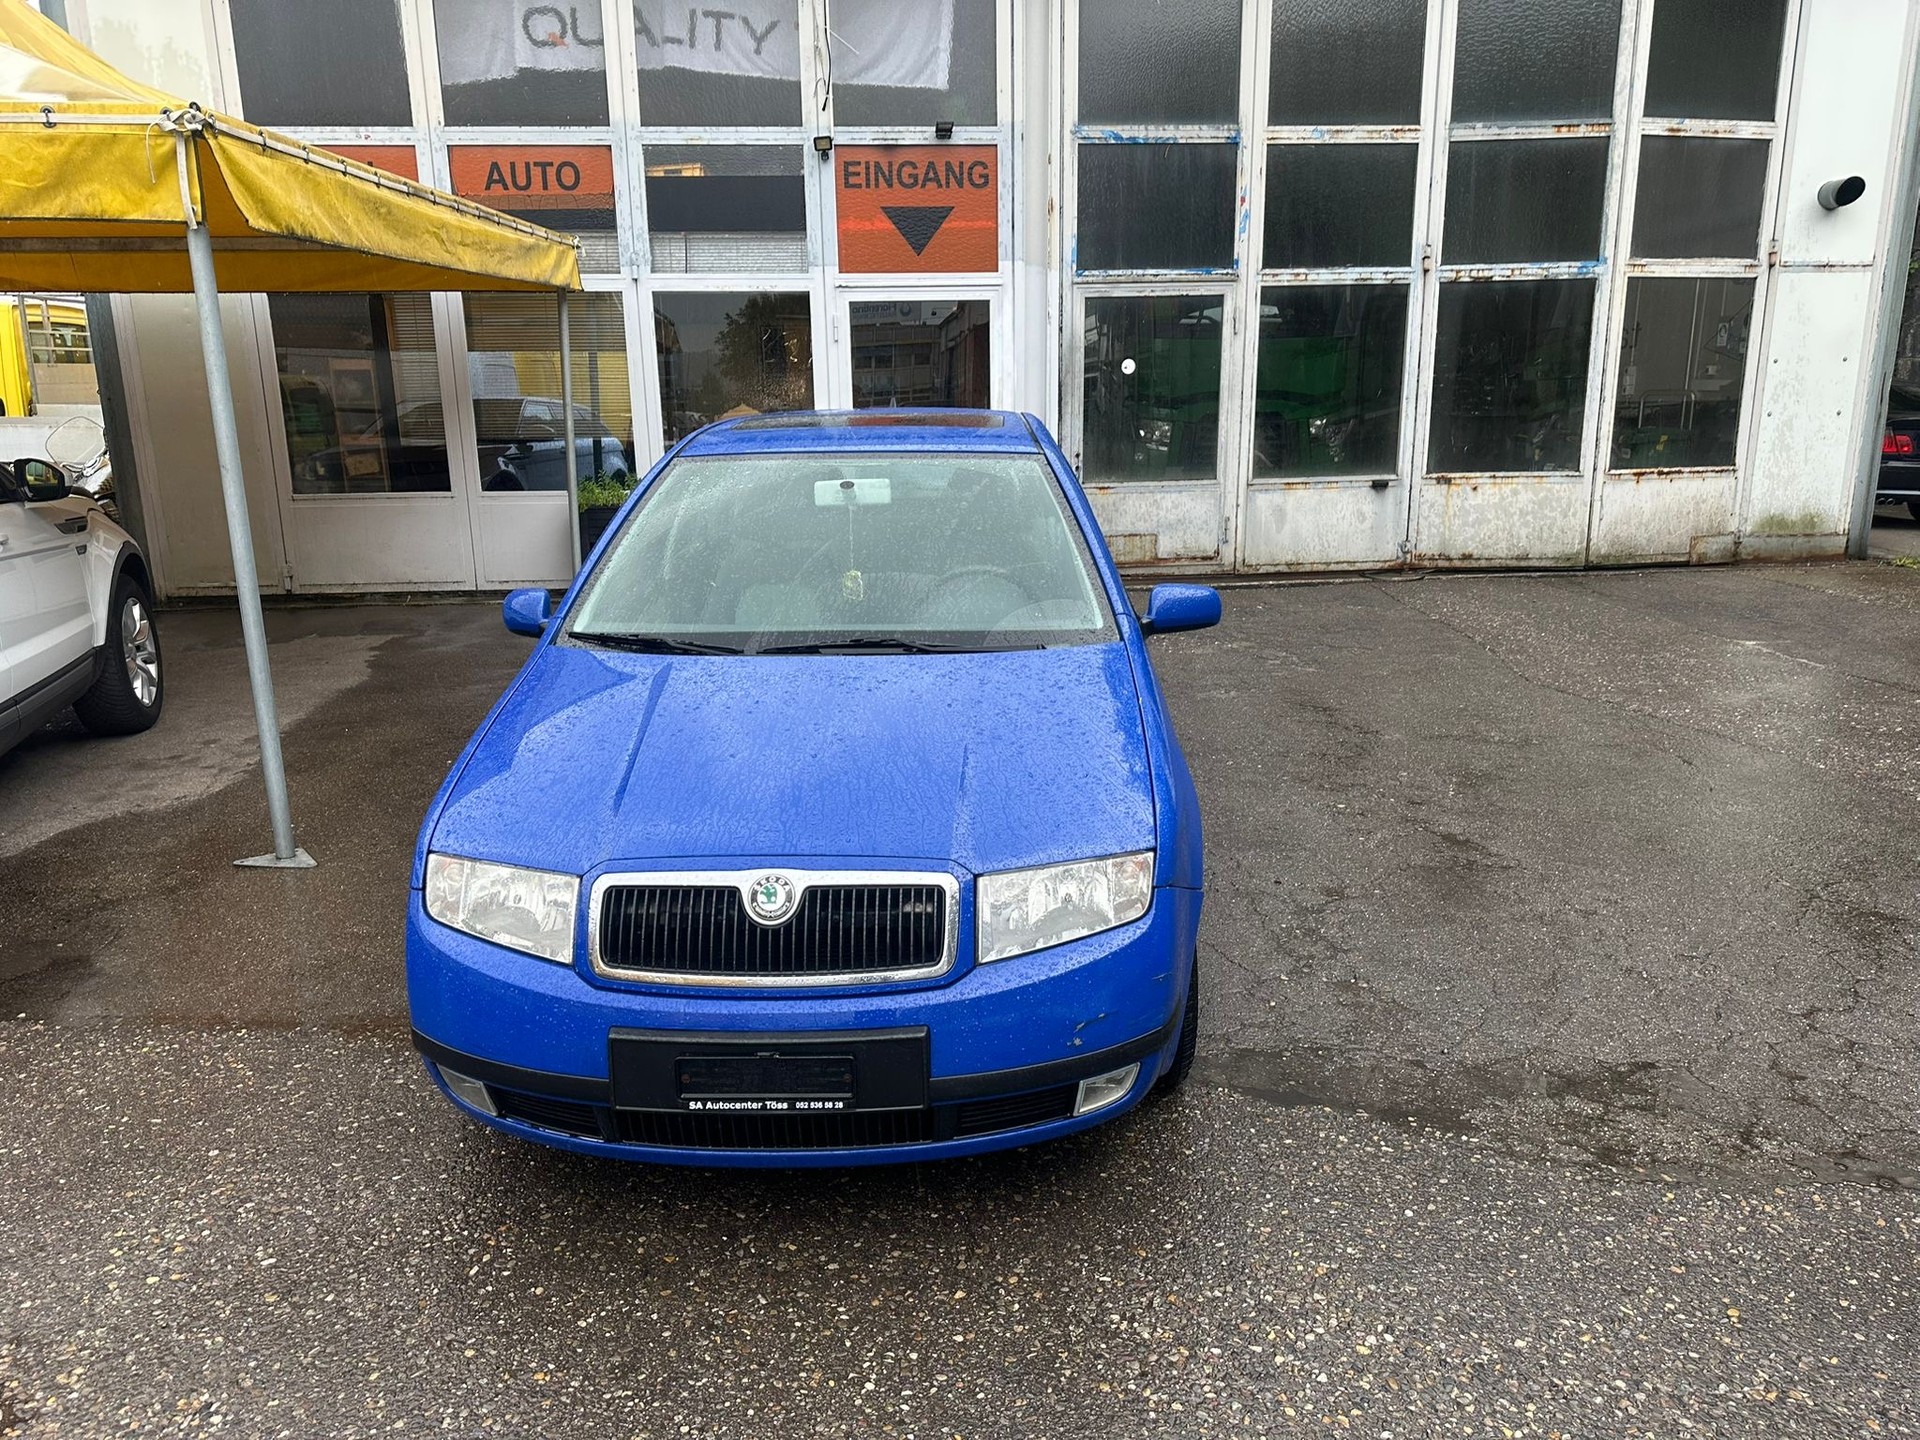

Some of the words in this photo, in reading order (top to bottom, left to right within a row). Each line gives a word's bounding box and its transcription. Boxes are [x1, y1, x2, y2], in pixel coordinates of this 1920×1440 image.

[484, 161, 581, 191] AUTO
[843, 160, 990, 189] EINGANG
[688, 1101, 703, 1110] SA
[705, 1101, 763, 1110] Autocenter
[765, 1100, 788, 1110] Töss
[795, 1101, 809, 1109] 052
[834, 1101, 844, 1109] 28
